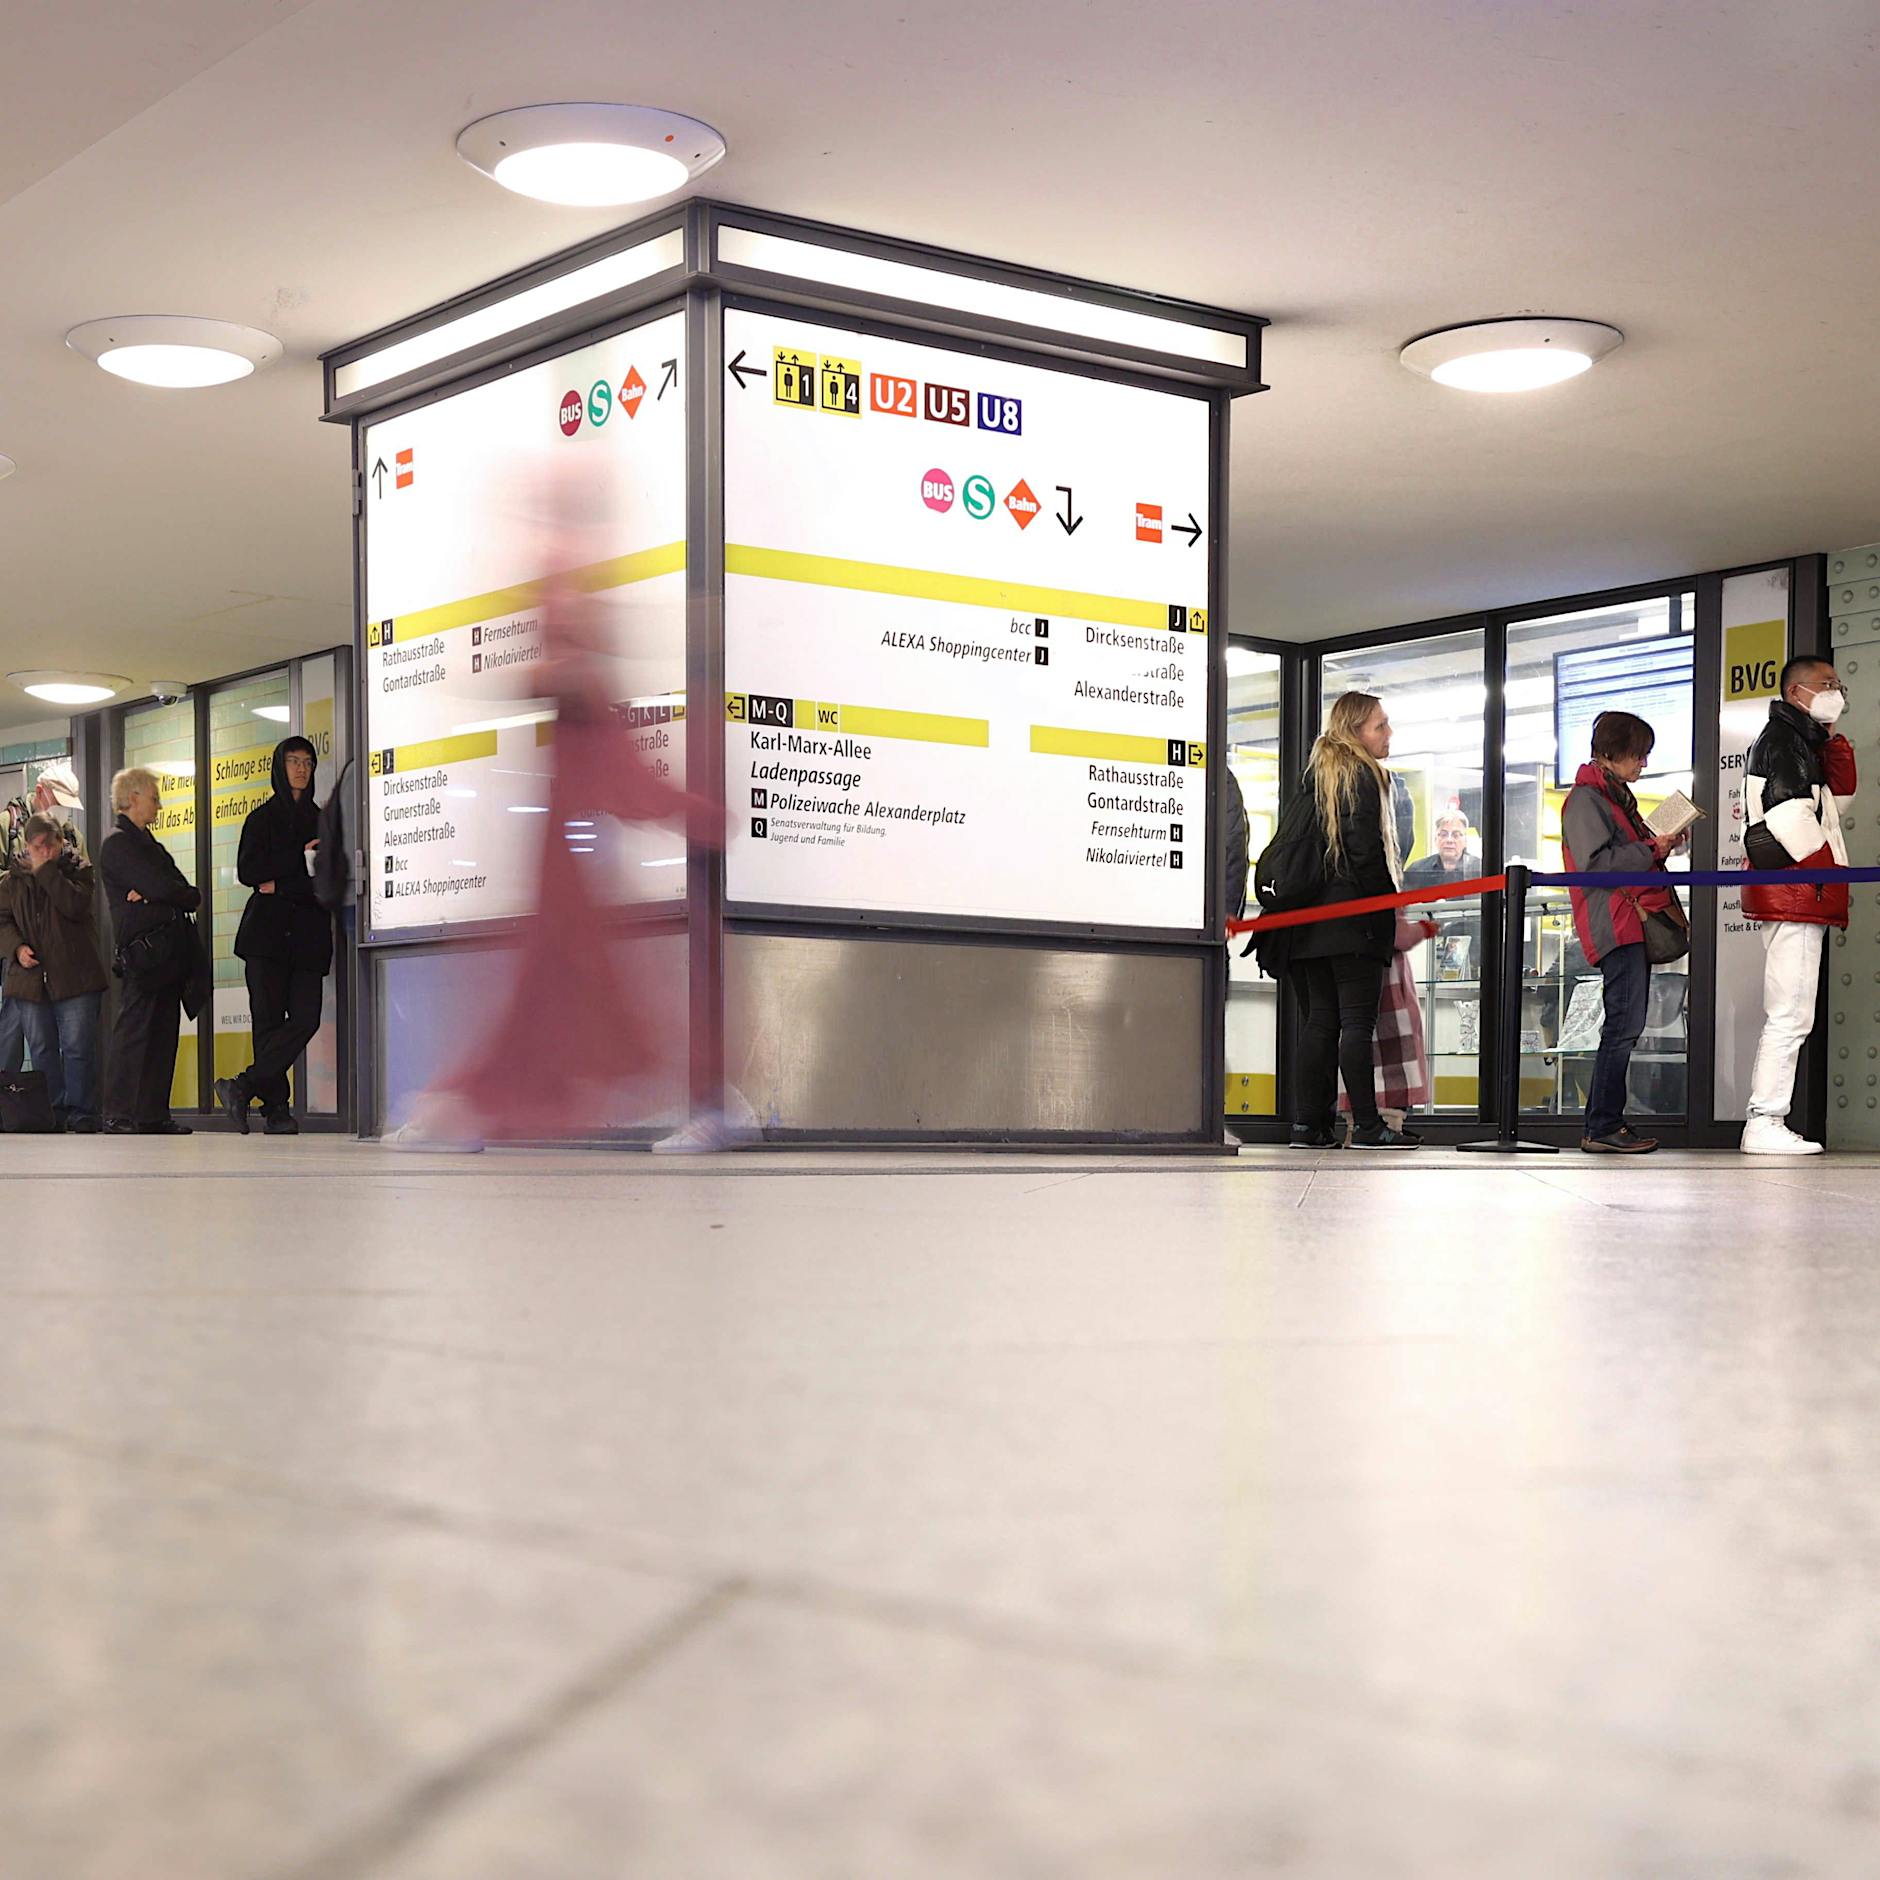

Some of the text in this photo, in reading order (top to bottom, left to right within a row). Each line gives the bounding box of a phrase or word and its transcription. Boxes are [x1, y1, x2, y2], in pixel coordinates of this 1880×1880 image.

[561, 386, 644, 423] BUS S Bahn
[802, 373, 1019, 431] 1 4 U2 U5 U8
[922, 478, 1162, 532] BUS S Bahn Tram
[384, 622, 391, 641] H
[483, 618, 538, 643] Fernsehturm
[1010, 619, 1032, 636] bcc
[1173, 610, 1181, 628] J
[382, 639, 444, 667] Rathausstraße
[881, 630, 925, 652] ALEXA
[930, 635, 1032, 665] Shoppingcenter
[1086, 627, 1185, 656] Dircksenstraße
[483, 643, 542, 669] Nikolaiviertel
[382, 666, 446, 692] Gontardstraße
[1731, 660, 1776, 694] BVG
[1074, 680, 1184, 708] Alexanderstraße
[752, 700, 838, 726] M-Q WC
[750, 732, 872, 760] Karl-Marx-Allee
[1172, 743, 1181, 760] H
[216, 760, 255, 781] Schlange
[750, 761, 862, 791] Ladenpassage
[1089, 764, 1184, 789] Rathausstraße
[162, 776, 175, 792] Nie
[383, 771, 448, 796] Dircksenstraße
[216, 798, 248, 819] einfach
[383, 800, 441, 822] Grunerstraße
[754, 792, 966, 824] M Polizeiwache Alexanderplatz
[1087, 792, 1184, 817] Gontardstraße
[166, 810, 181, 828] das
[754, 820, 765, 837] Q
[770, 817, 841, 834] Senatsverwaltung
[843, 823, 854, 832] für
[1092, 821, 1180, 841] Fernsehturm H
[384, 824, 455, 847] Alexanderstraße
[770, 832, 846, 846] Jugend und Familie
[395, 858, 408, 871] bcc
[1086, 847, 1180, 868] Nikolaiviertel H
[395, 876, 420, 896] ALEXA
[423, 875, 486, 894] Shoppingcenter
[1724, 923, 1744, 932] Ticket
[1746, 922, 1751, 931] &
